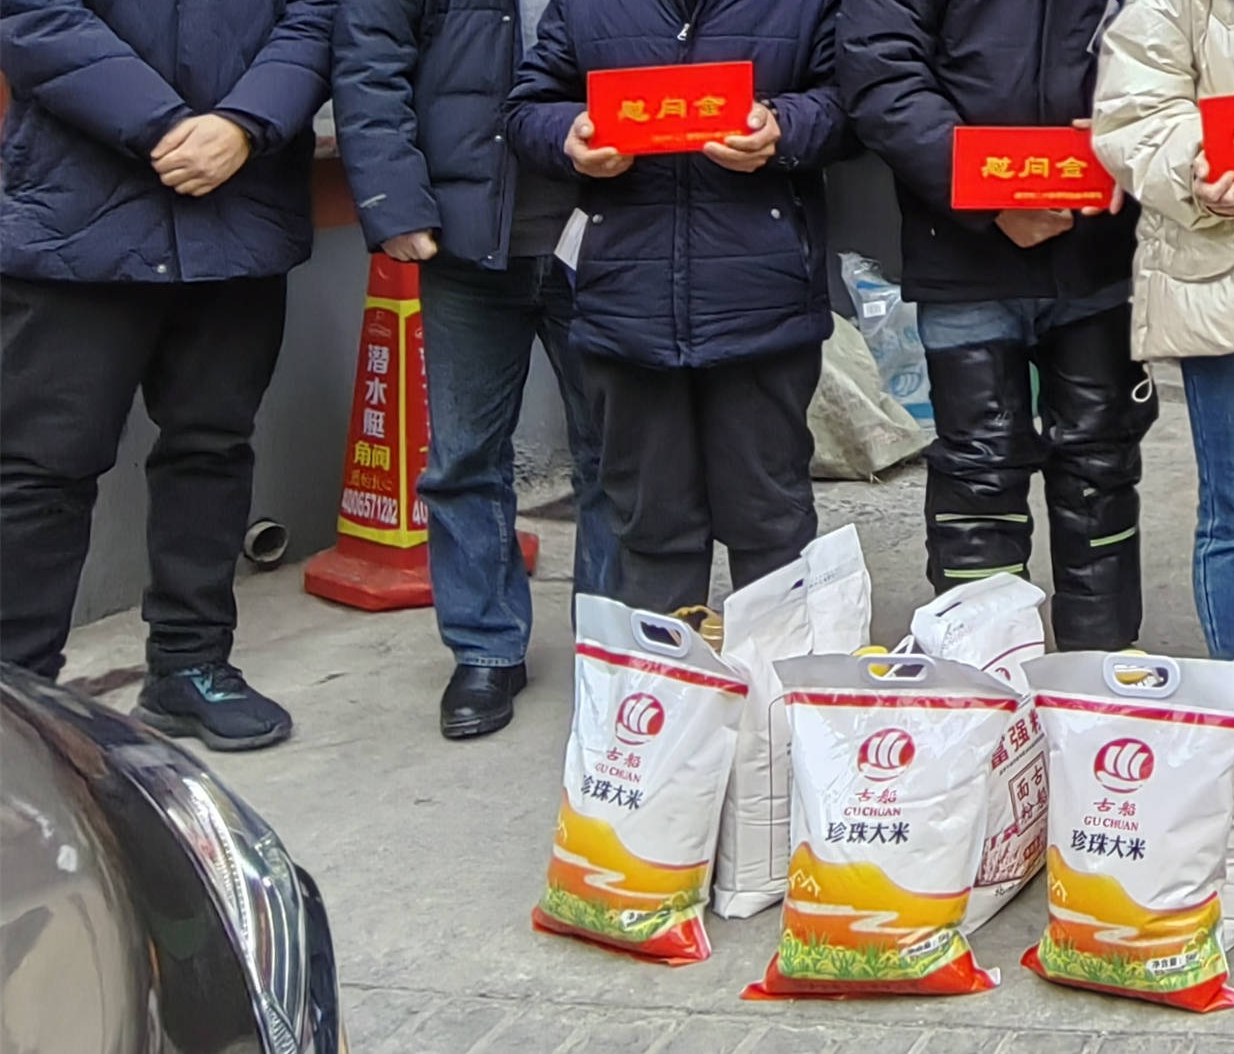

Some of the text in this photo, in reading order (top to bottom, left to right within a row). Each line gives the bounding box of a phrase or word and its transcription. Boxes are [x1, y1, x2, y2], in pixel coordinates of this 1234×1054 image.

[617, 96, 726, 123] 慰问金
[981, 156, 1089, 179] 慰问金
[362, 343, 390, 439] 潜水艇
[353, 440, 391, 472] 角阀
[824, 821, 910, 845] 珍珠大米
[1070, 829, 1146, 861] 珍珠大米
